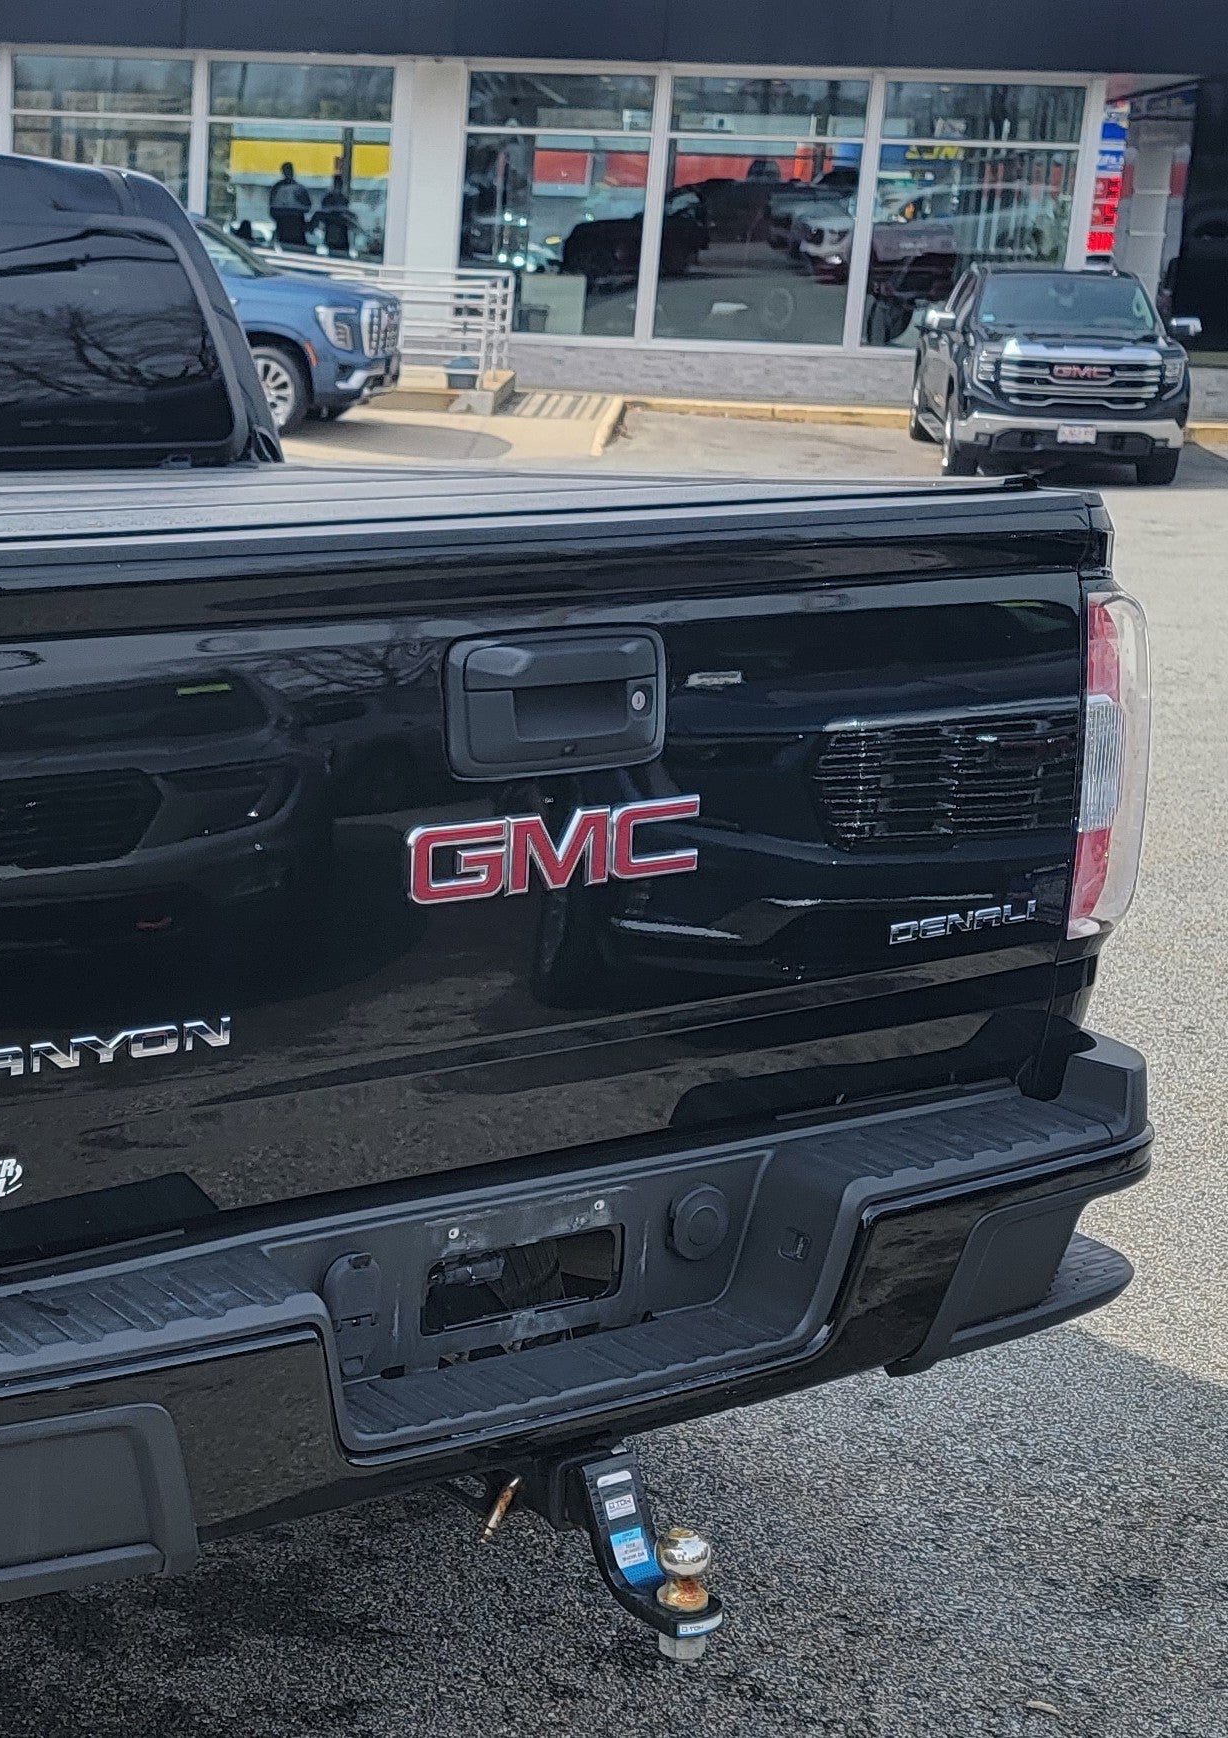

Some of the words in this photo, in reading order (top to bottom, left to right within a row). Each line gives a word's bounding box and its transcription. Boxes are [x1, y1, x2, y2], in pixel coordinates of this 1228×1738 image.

[1052, 364, 1112, 379] GMC
[406, 794, 700, 904] GMC
[889, 900, 1036, 945] DENALI
